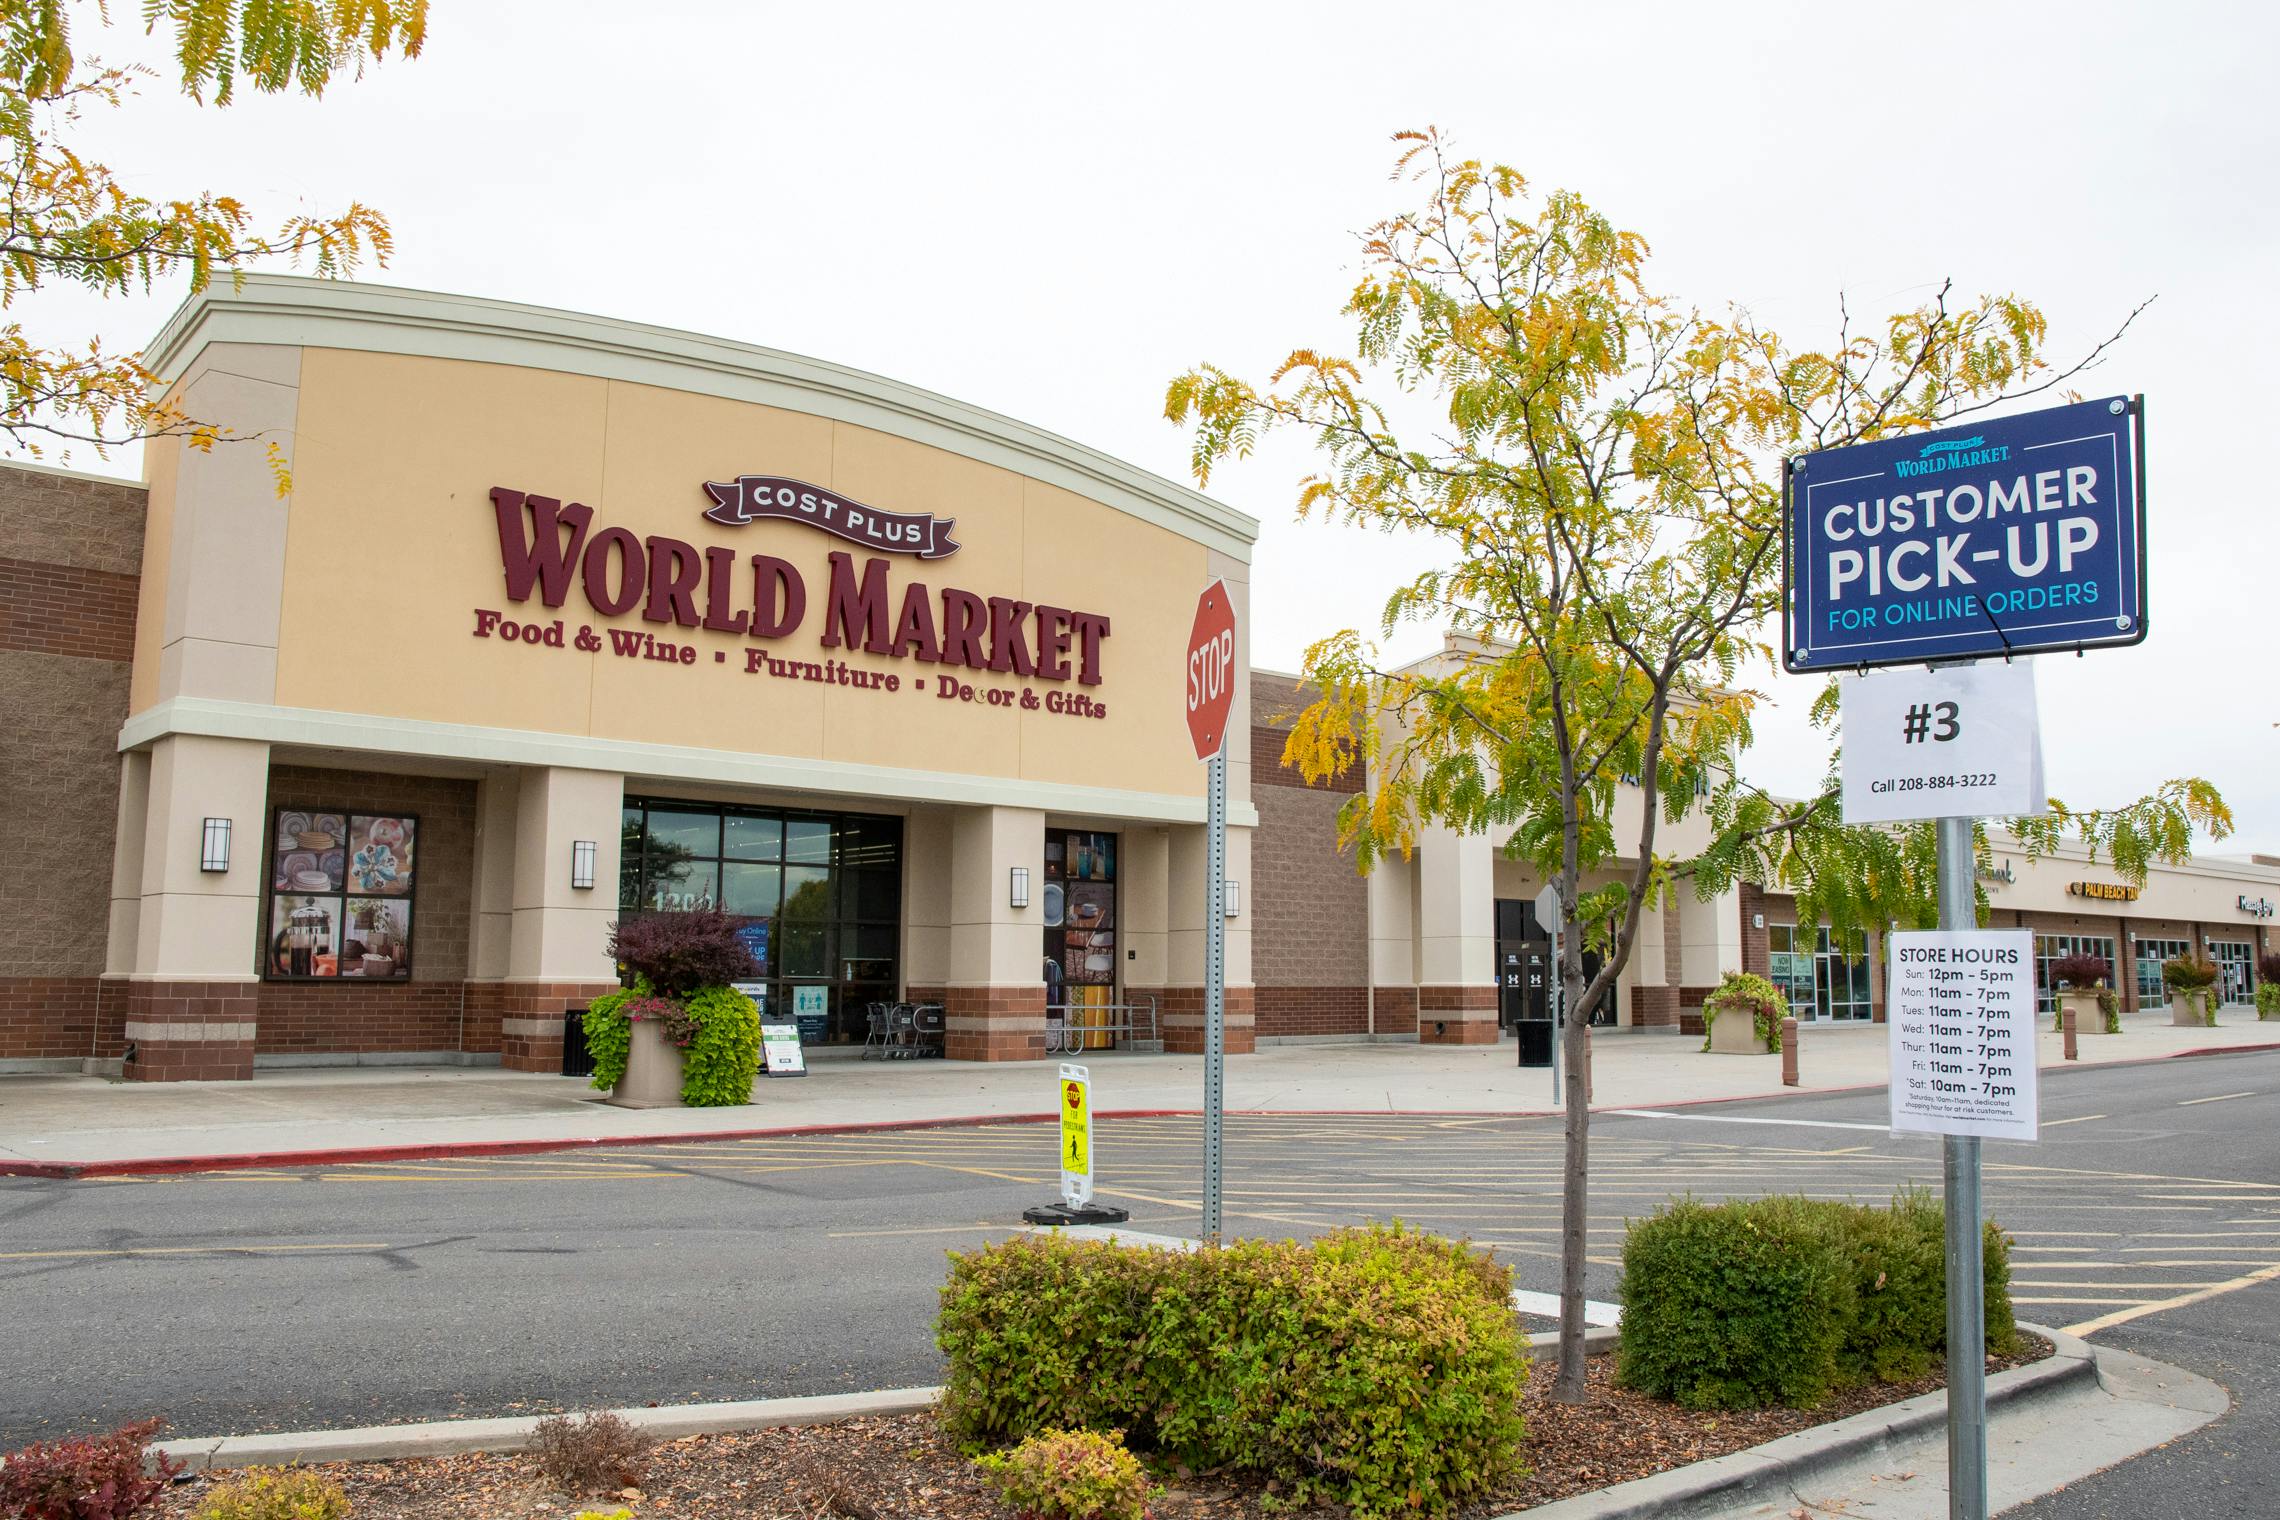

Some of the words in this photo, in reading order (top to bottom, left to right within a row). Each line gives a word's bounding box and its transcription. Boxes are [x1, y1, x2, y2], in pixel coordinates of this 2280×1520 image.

[1929, 443, 1950, 451] COST
[1953, 440, 1975, 448] PLUS
[1895, 457, 1946, 478] WORLD
[1824, 465, 2098, 541] CUSTOMER
[753, 486, 838, 519] COST
[847, 510, 922, 543] PLUS
[1828, 517, 2099, 600] PICK-UP
[489, 486, 806, 639] WORLD
[820, 551, 1111, 686] MARKET
[1828, 607, 1877, 631] FOR
[1884, 595, 1978, 625] ONLINE
[1986, 581, 2099, 615] ORDERS
[473, 608, 566, 649] Food
[574, 624, 602, 653] &
[607, 628, 697, 666] Wine
[744, 648, 900, 692] Furniture
[1019, 687, 1040, 711] &
[1045, 690, 1107, 719] Gifts
[1189, 628, 1232, 712] STOP
[1903, 701, 1961, 744] #3
[1871, 778, 1895, 793] Call
[1898, 773, 1997, 791] 208-884-3222
[2085, 882, 2103, 898] PALM
[2104, 884, 2126, 900] BEACH
[1900, 948, 1946, 963] STORE
[1951, 948, 2019, 964] HOURS
[1905, 968, 1925, 979] Sun:
[1929, 968, 1963, 983] 12pm
[1980, 969, 2014, 984] 5pm
[1901, 987, 1925, 997] Mon:
[1929, 987, 1962, 999] 11am
[1978, 988, 2010, 1003] 7pm
[1901, 1005, 1925, 1015] Tues:
[1929, 1005, 1962, 1017] 11am
[1978, 1007, 2010, 1022] 7pm
[1902, 1024, 1925, 1034] Wed:
[1929, 1024, 1962, 1036] 11am
[1978, 1025, 2011, 1041] 7pm
[1902, 1041, 1925, 1052] Thur:
[1929, 1043, 1962, 1055] 11am
[1978, 1044, 2011, 1060] 7pm
[1912, 1060, 1926, 1071] Fri:
[1930, 1061, 1962, 1074] 11am
[1979, 1063, 2012, 1079] 7pm
[1067, 1090, 1080, 1101] STOP
[1931, 1079, 1966, 1093] 10am
[1982, 1082, 2015, 1098] 7pm
[1905, 1101, 1930, 1111] shopping
[1944, 1104, 1953, 1112] for
[1976, 1107, 2015, 1116] customers.
[1974, 1098, 2010, 1107] dedicated
